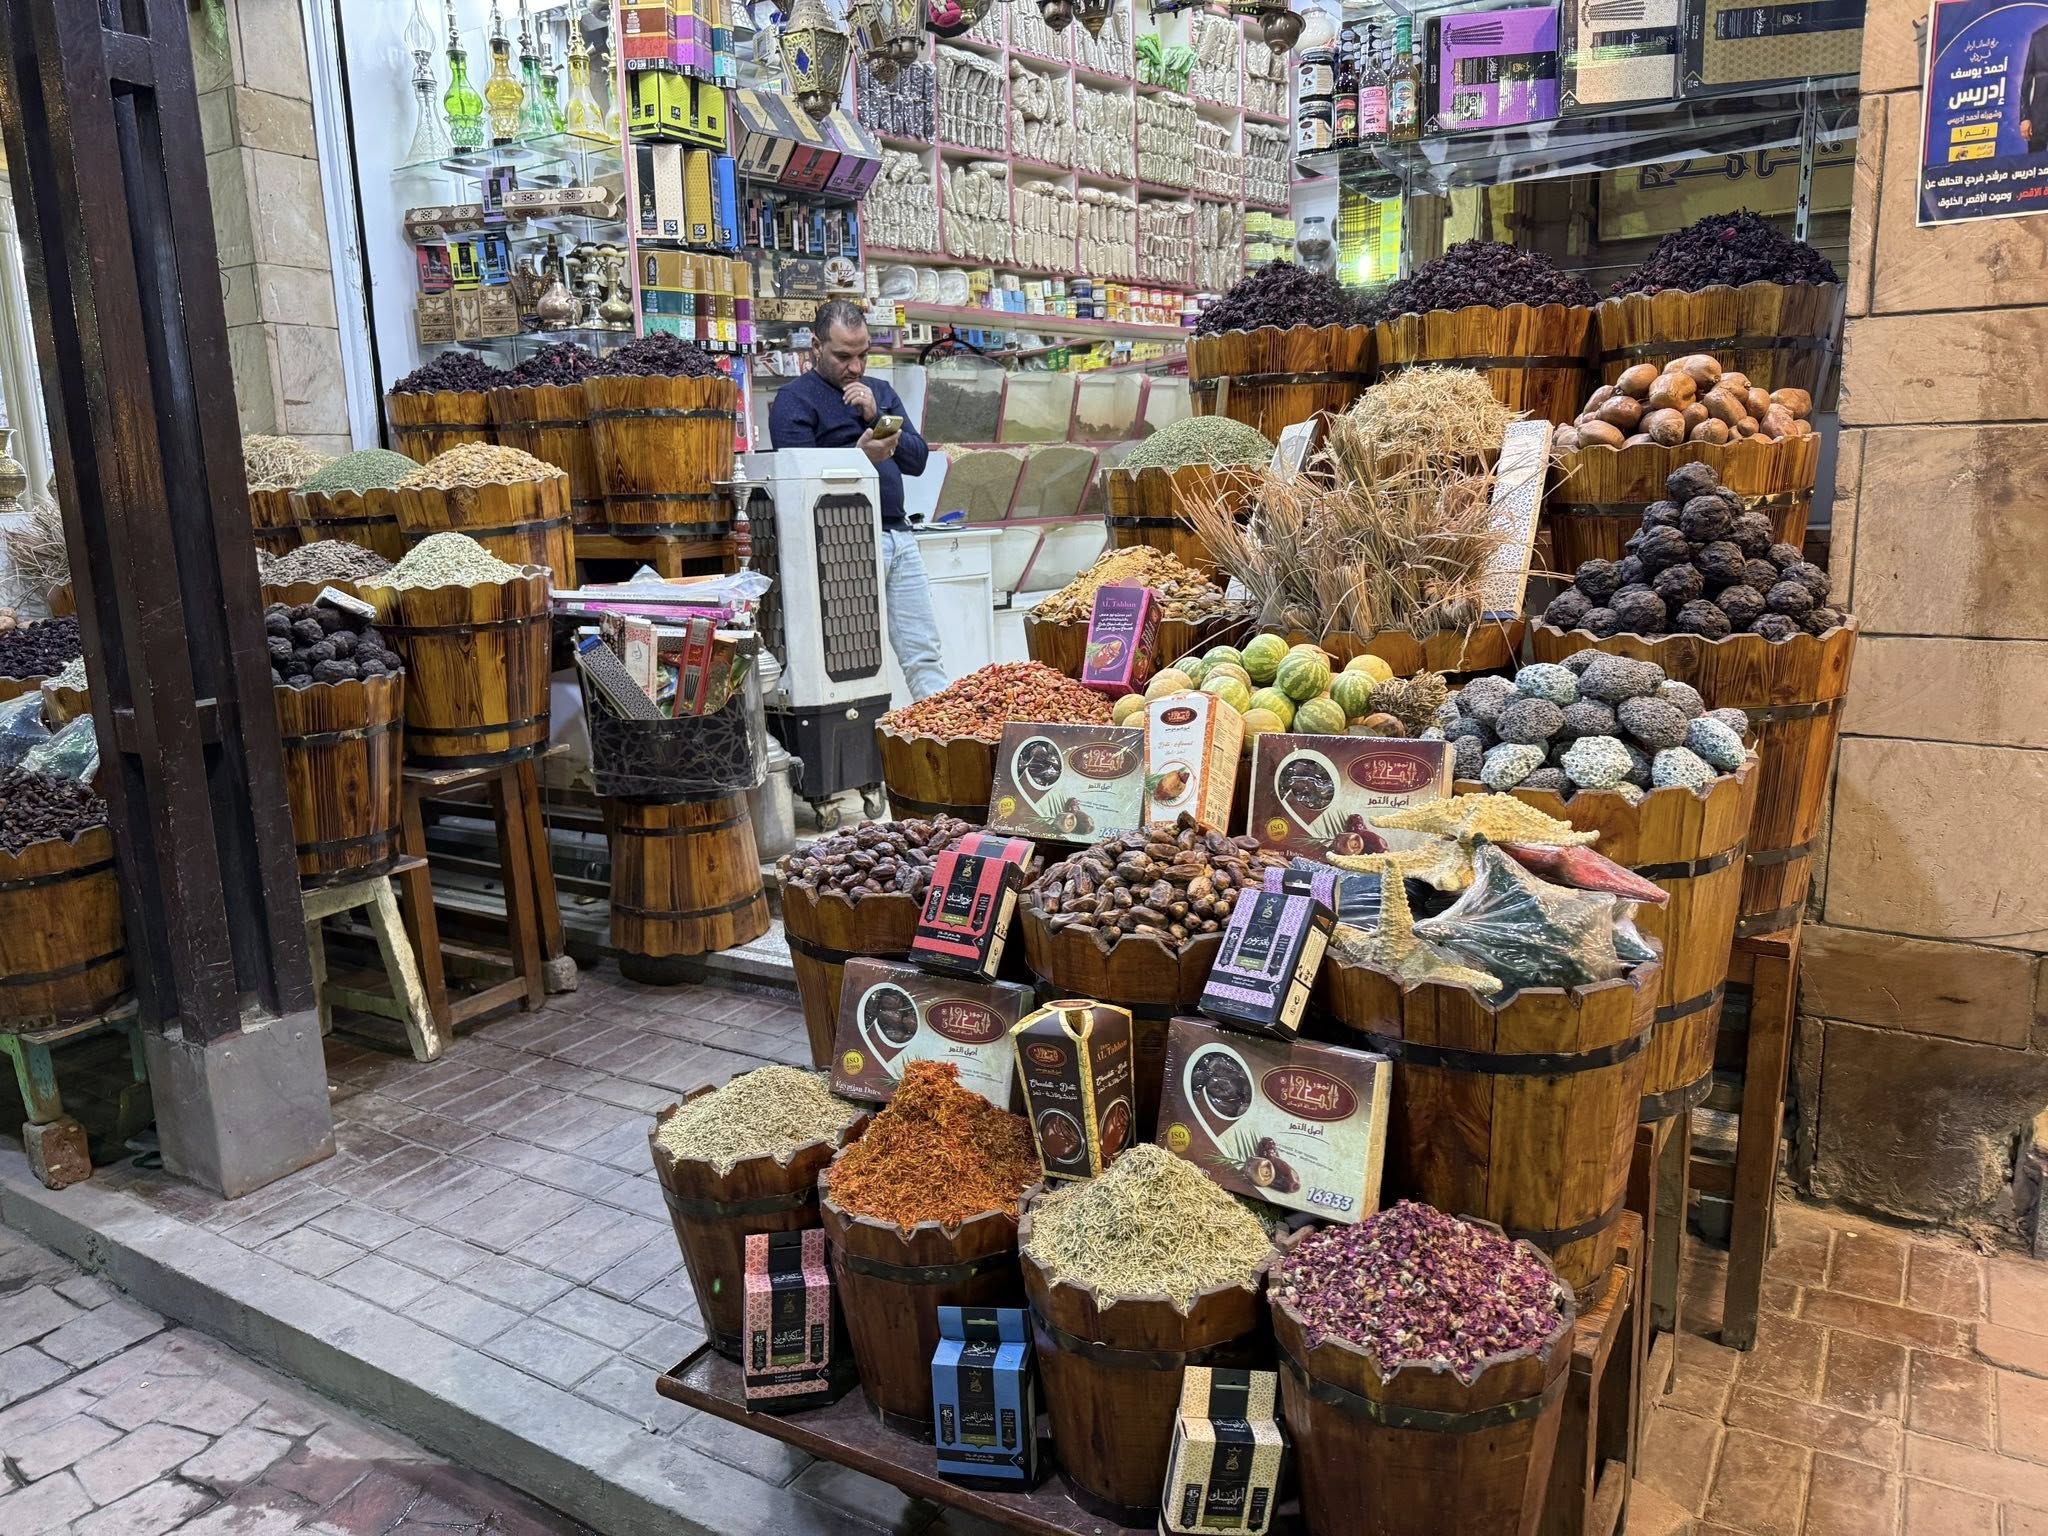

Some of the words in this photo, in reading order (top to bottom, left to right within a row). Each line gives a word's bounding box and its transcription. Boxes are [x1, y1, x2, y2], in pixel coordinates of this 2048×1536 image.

[1984, 56, 2008, 74] أحمد
[1951, 67, 1982, 79] يوسف
[1949, 77, 2006, 109] إدريس
[1965, 127, 1990, 139] رقم
[1985, 170, 2008, 184] مرشح
[2012, 167, 2036, 179] إدريس
[1925, 181, 1936, 190] عن
[1938, 176, 1963, 187] التحالف
[1964, 173, 1984, 187] فردي
[1989, 191, 2012, 202] وصوت
[1368, 796, 1388, 805] التمر
[1390, 795, 1409, 807] أصل
[1098, 827, 1118, 838] 168
[1270, 823, 1283, 832] ISO
[964, 1047, 978, 1056] أصل
[836, 1080, 863, 1093] Egyptian
[1289, 1122, 1306, 1131] التمر
[1307, 1125, 1324, 1135] أصل
[1171, 1131, 1185, 1139] ISO
[1306, 1187, 1354, 1211] 16833
[941, 1409, 952, 1417] 45
[1187, 1489, 1199, 1498] 45
